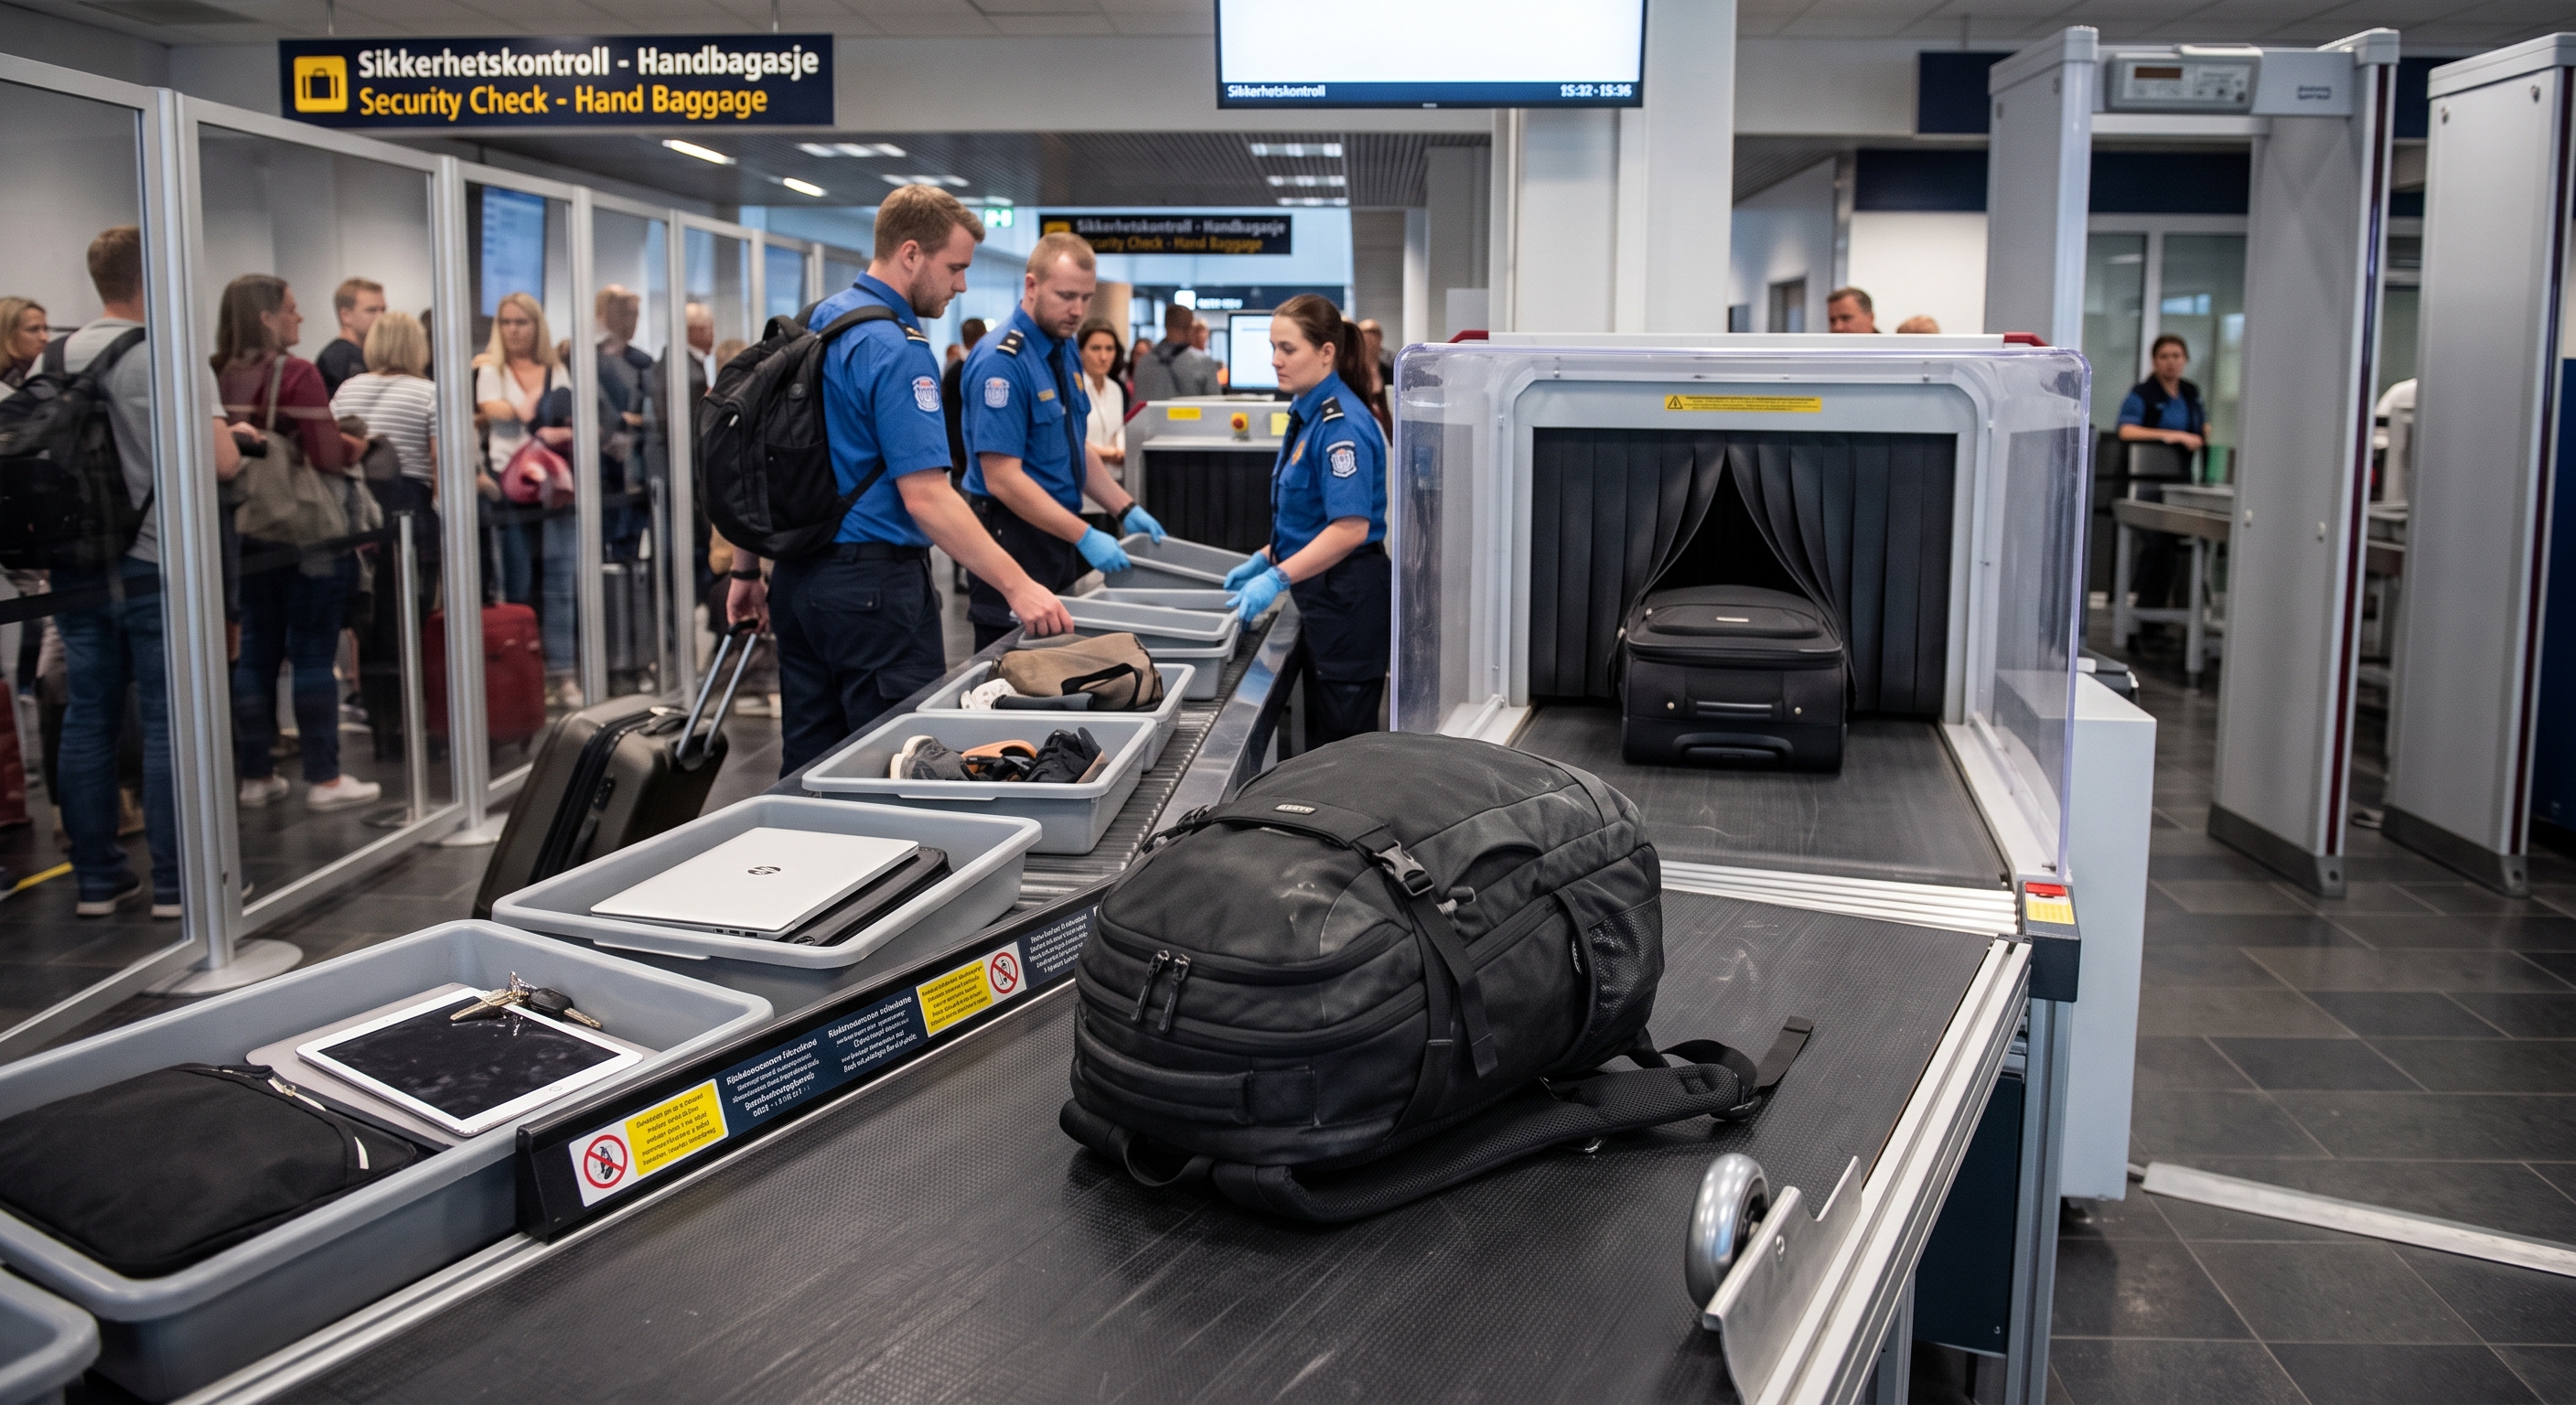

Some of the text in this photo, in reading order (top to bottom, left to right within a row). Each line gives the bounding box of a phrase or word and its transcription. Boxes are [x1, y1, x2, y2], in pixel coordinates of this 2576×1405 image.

[358, 47, 609, 79] Sikkerhetskontroll
[639, 44, 820, 80] Handbagasje
[360, 86, 460, 121] Security
[469, 84, 549, 114] Check
[575, 84, 643, 113] Hand
[652, 85, 767, 119] Baggage
[1227, 84, 1326, 98] Sikkerhetskontroll
